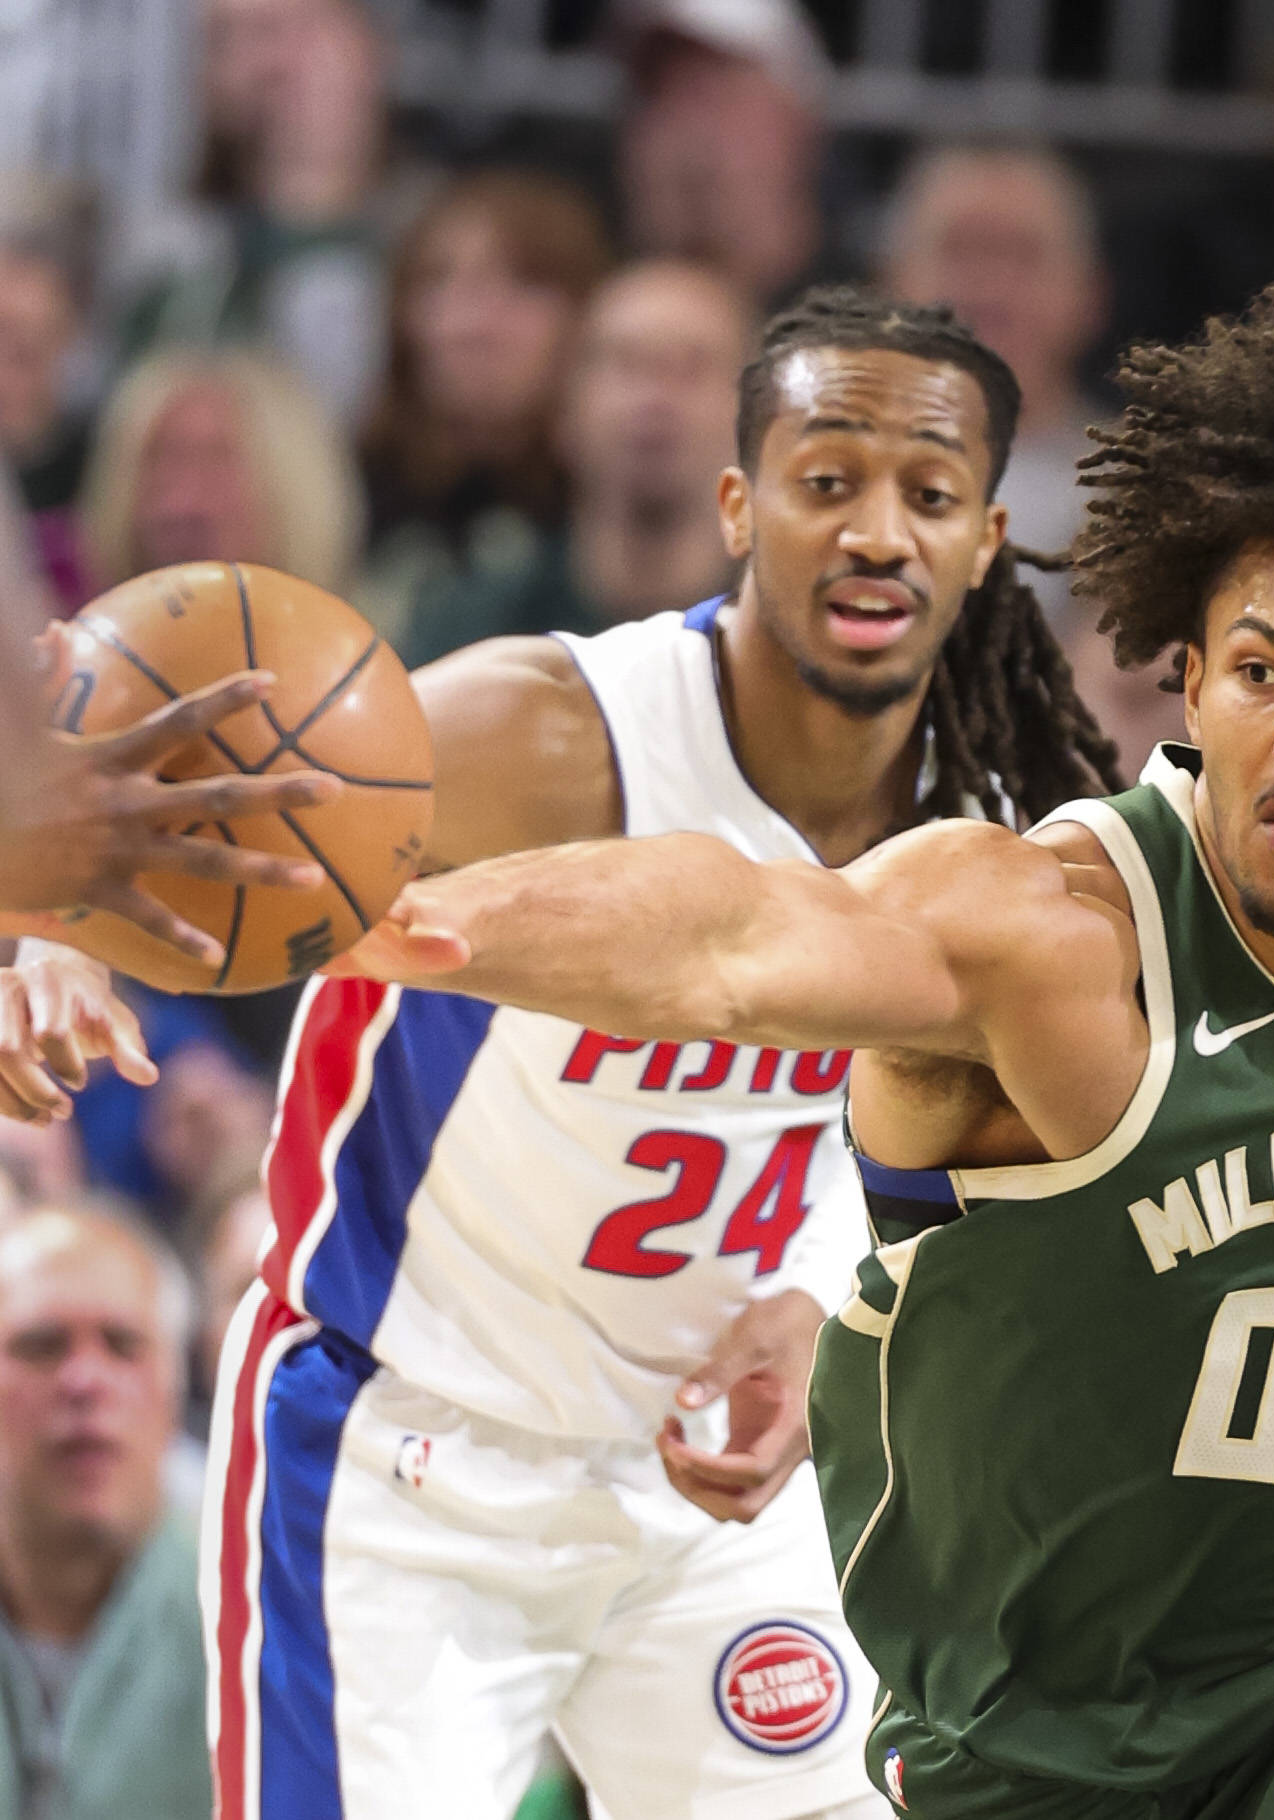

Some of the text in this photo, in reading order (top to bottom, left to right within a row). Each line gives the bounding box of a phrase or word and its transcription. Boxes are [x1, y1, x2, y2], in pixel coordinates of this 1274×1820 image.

[581, 1121, 829, 1279] 24
[737, 1656, 820, 1694] DETROIT
[743, 1678, 828, 1719] PISTONS
